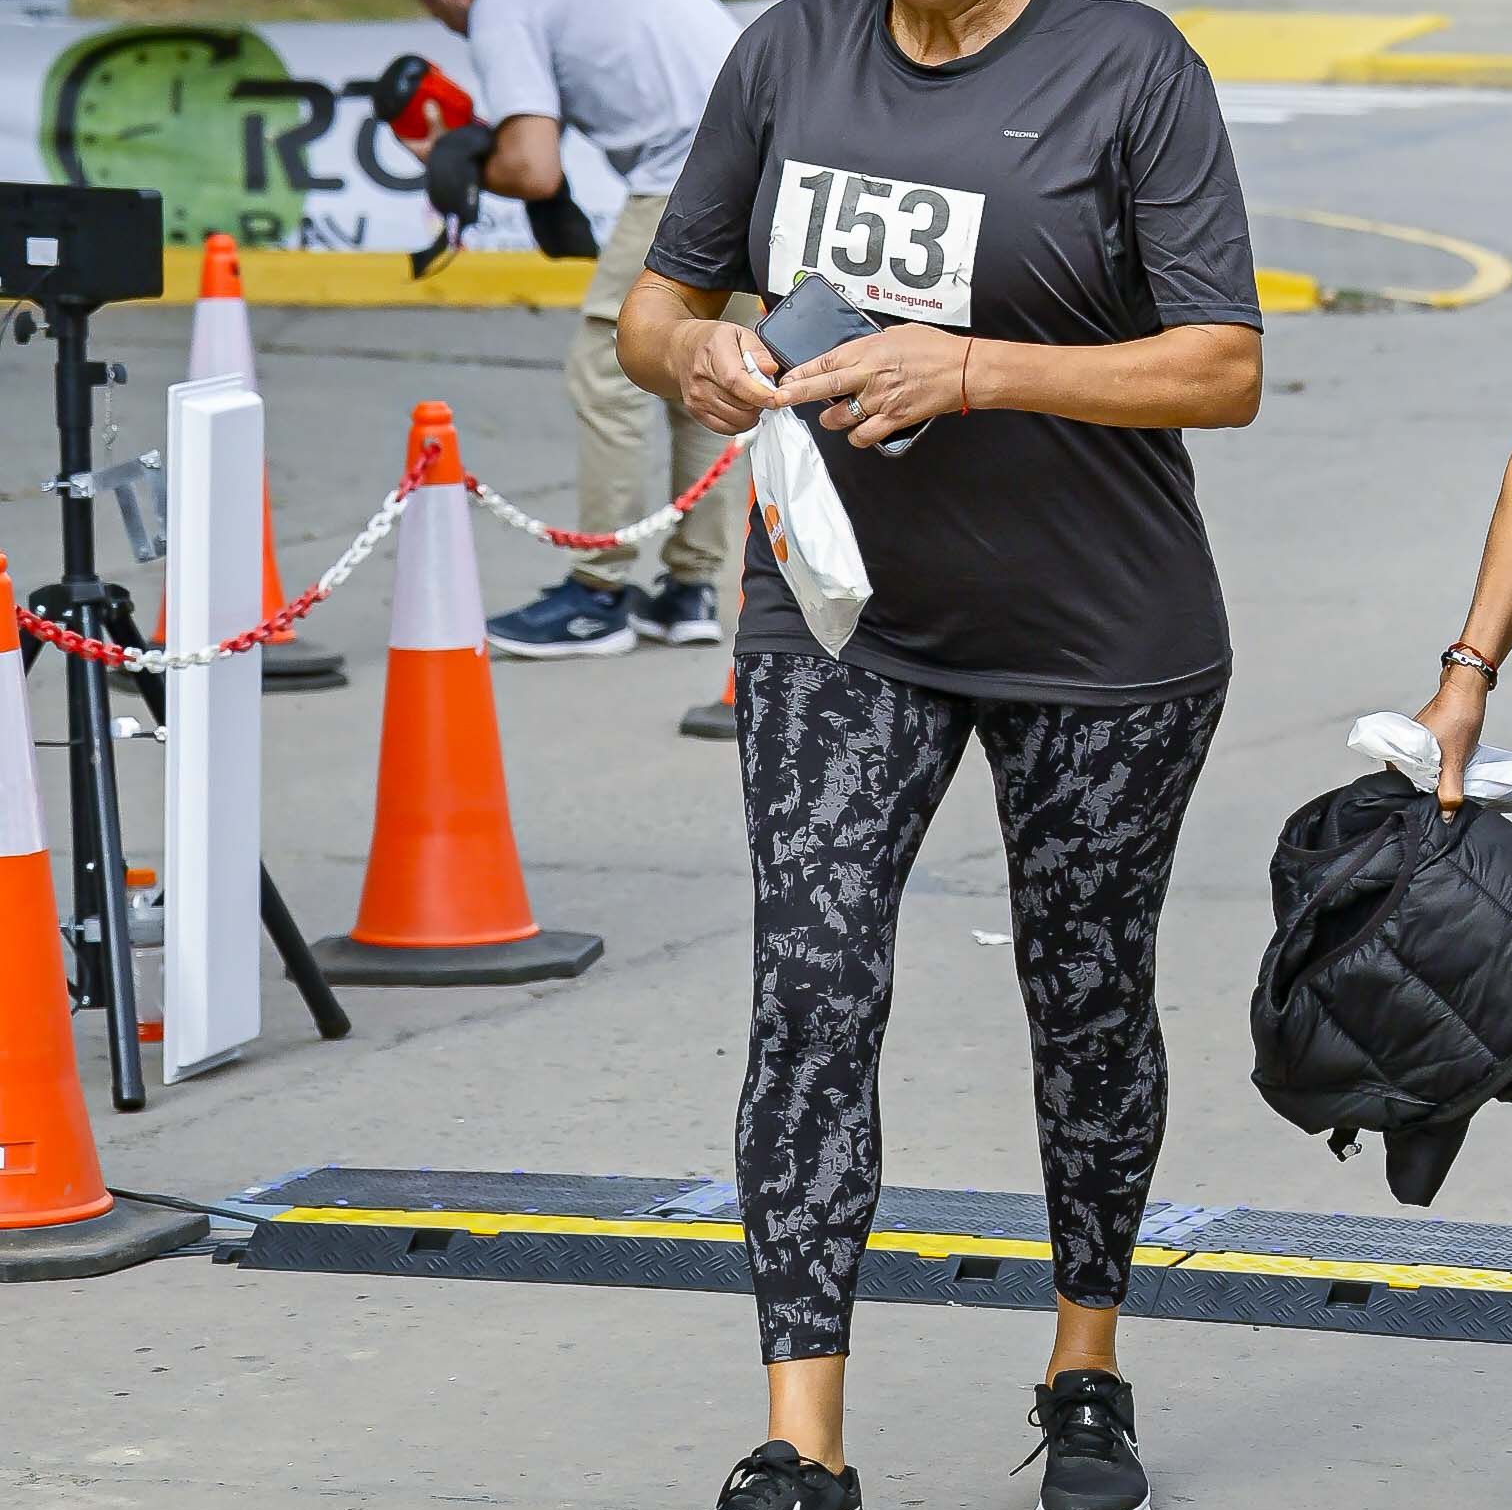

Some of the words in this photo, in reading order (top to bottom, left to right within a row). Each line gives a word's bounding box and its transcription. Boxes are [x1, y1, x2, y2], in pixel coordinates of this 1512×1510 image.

[799, 170, 951, 290] 153
[883, 288, 893, 300] la
[894, 294, 943, 310] segunda
